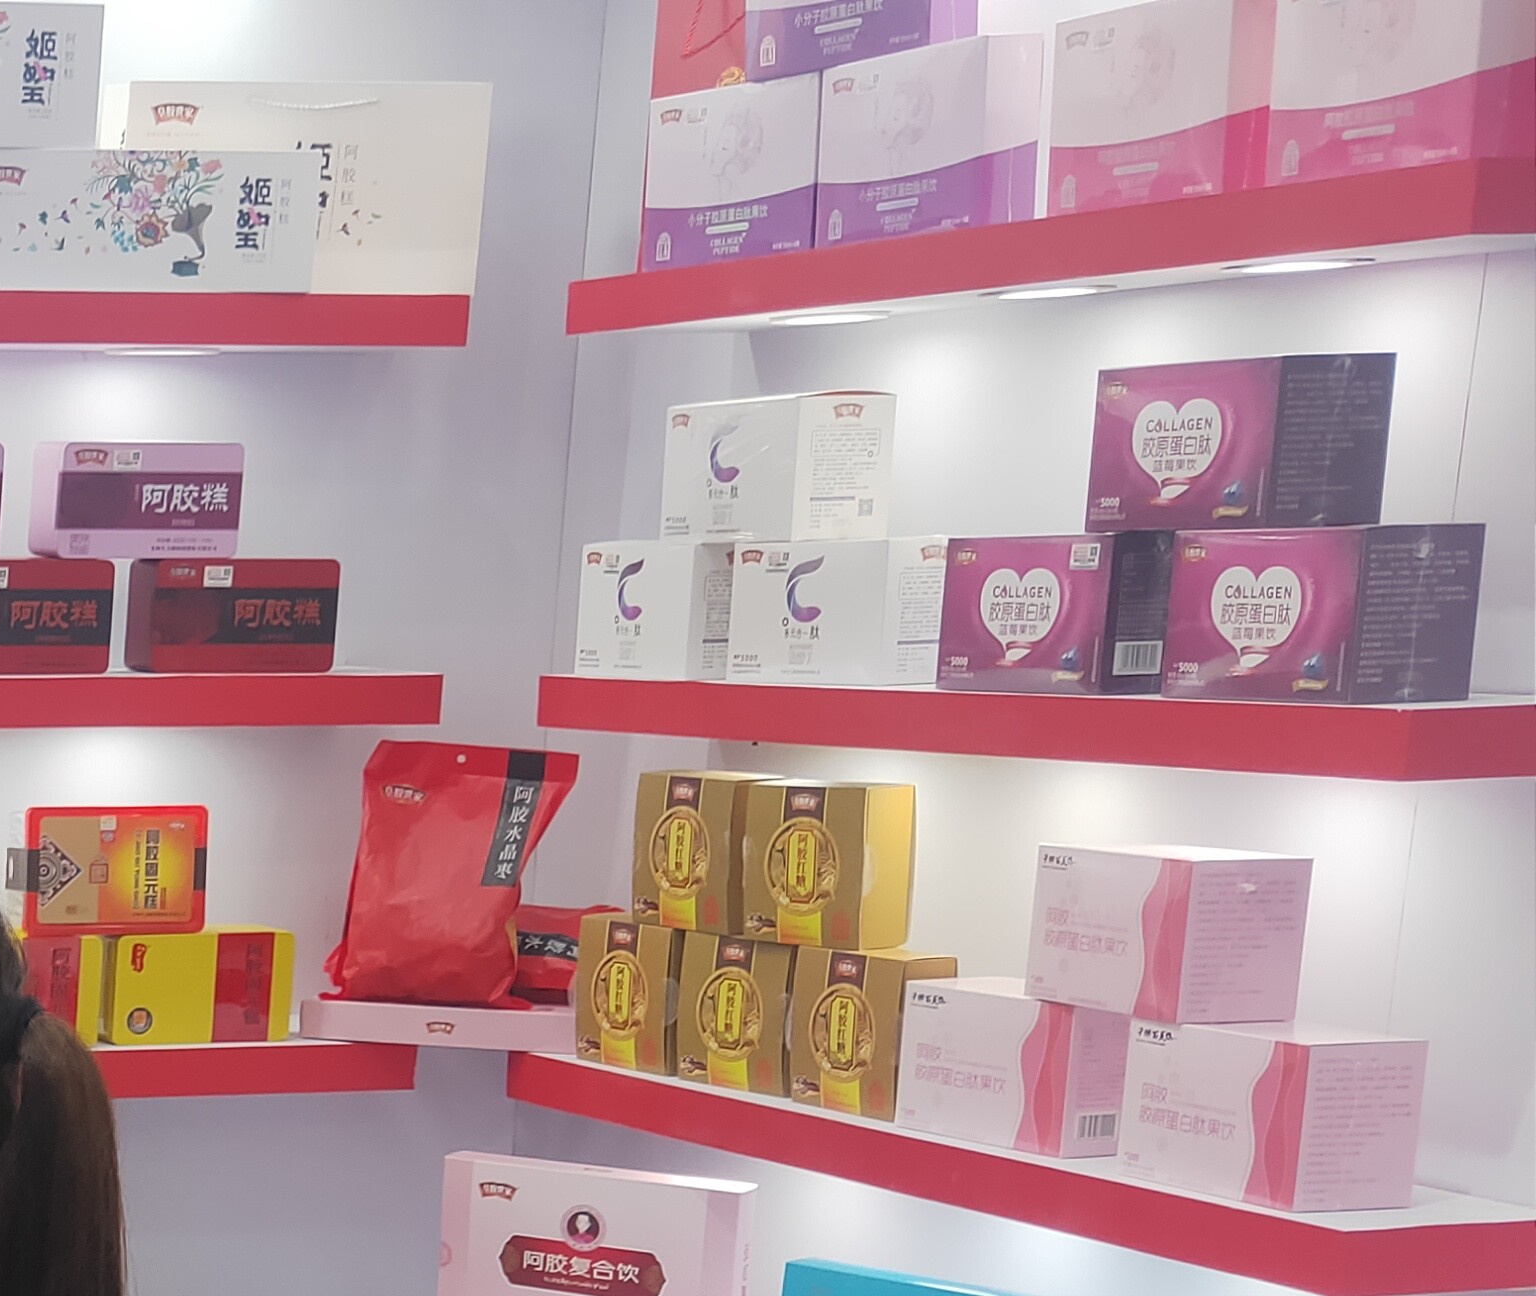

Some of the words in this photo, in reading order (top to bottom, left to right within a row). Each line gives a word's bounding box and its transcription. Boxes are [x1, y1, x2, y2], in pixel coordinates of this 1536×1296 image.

[1146, 417, 1213, 433] COLLAGEN
[1141, 435, 1212, 459] 胶原蛋白肽
[141, 483, 229, 513] 阿胶糕
[993, 584, 1052, 599] COLLAGEN
[1225, 585, 1292, 600] COLLAGEN
[10, 599, 98, 629] 阿胶糕
[234, 598, 321, 629] 阿胶糕
[988, 600, 1051, 623] 胶原蛋白肽
[1220, 603, 1292, 626] 胶原蛋白肽
[522, 1250, 640, 1284] 阿胶复合饮
